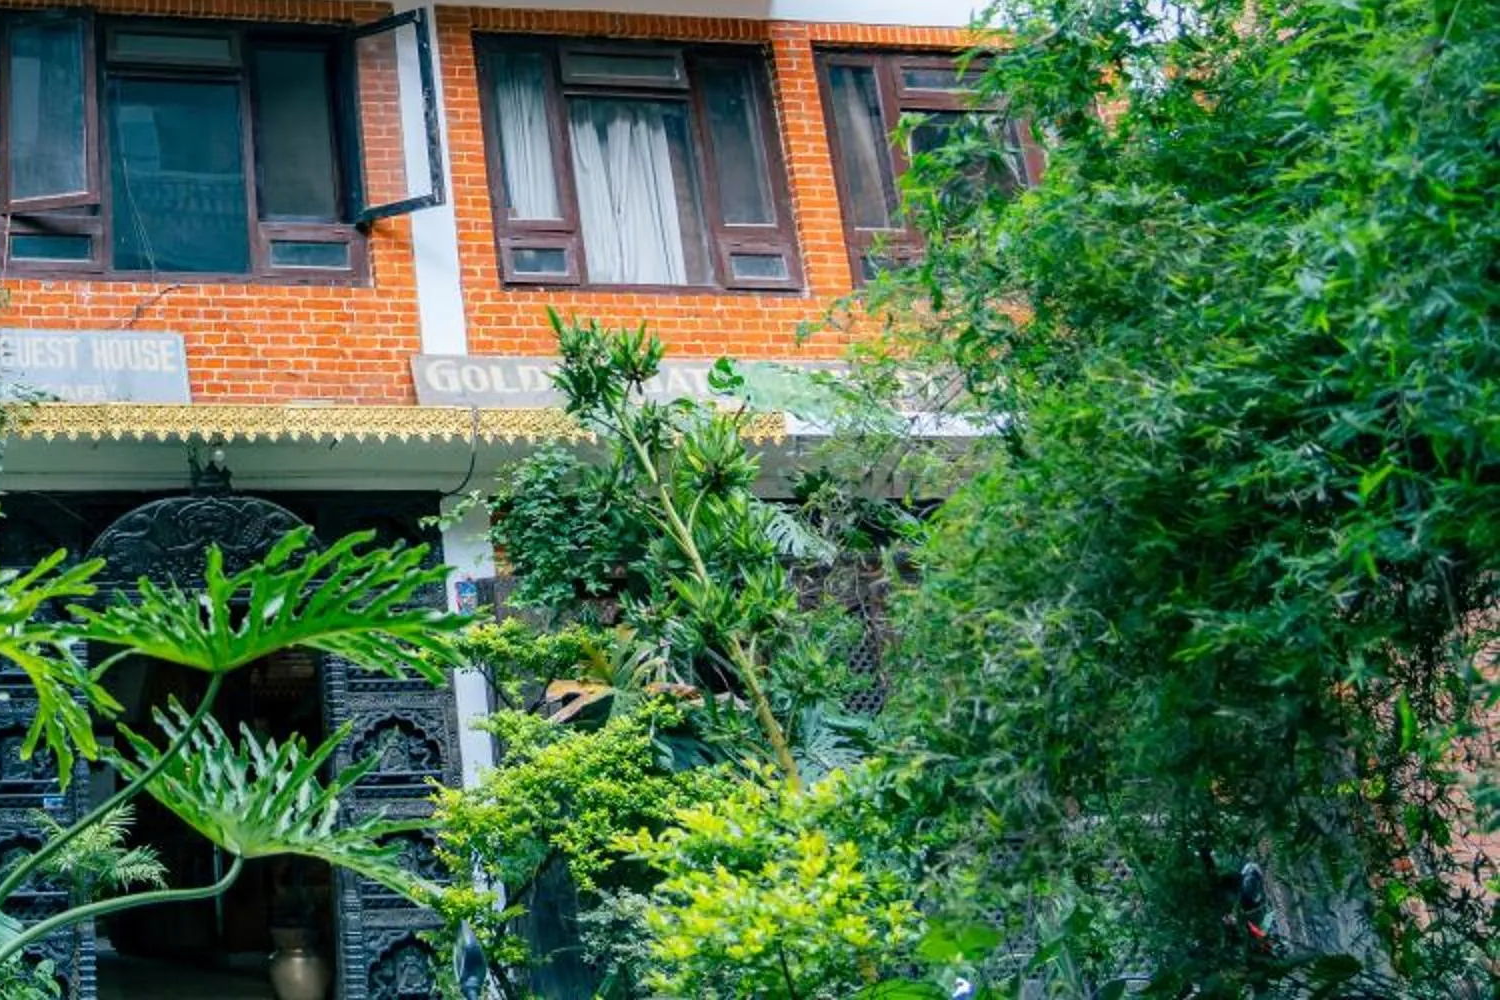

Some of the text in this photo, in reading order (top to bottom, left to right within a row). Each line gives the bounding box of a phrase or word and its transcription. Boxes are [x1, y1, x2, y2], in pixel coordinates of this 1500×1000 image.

[0, 335, 79, 369] GUEST
[91, 338, 177, 373] HOUSE
[424, 359, 552, 394] GOLD
